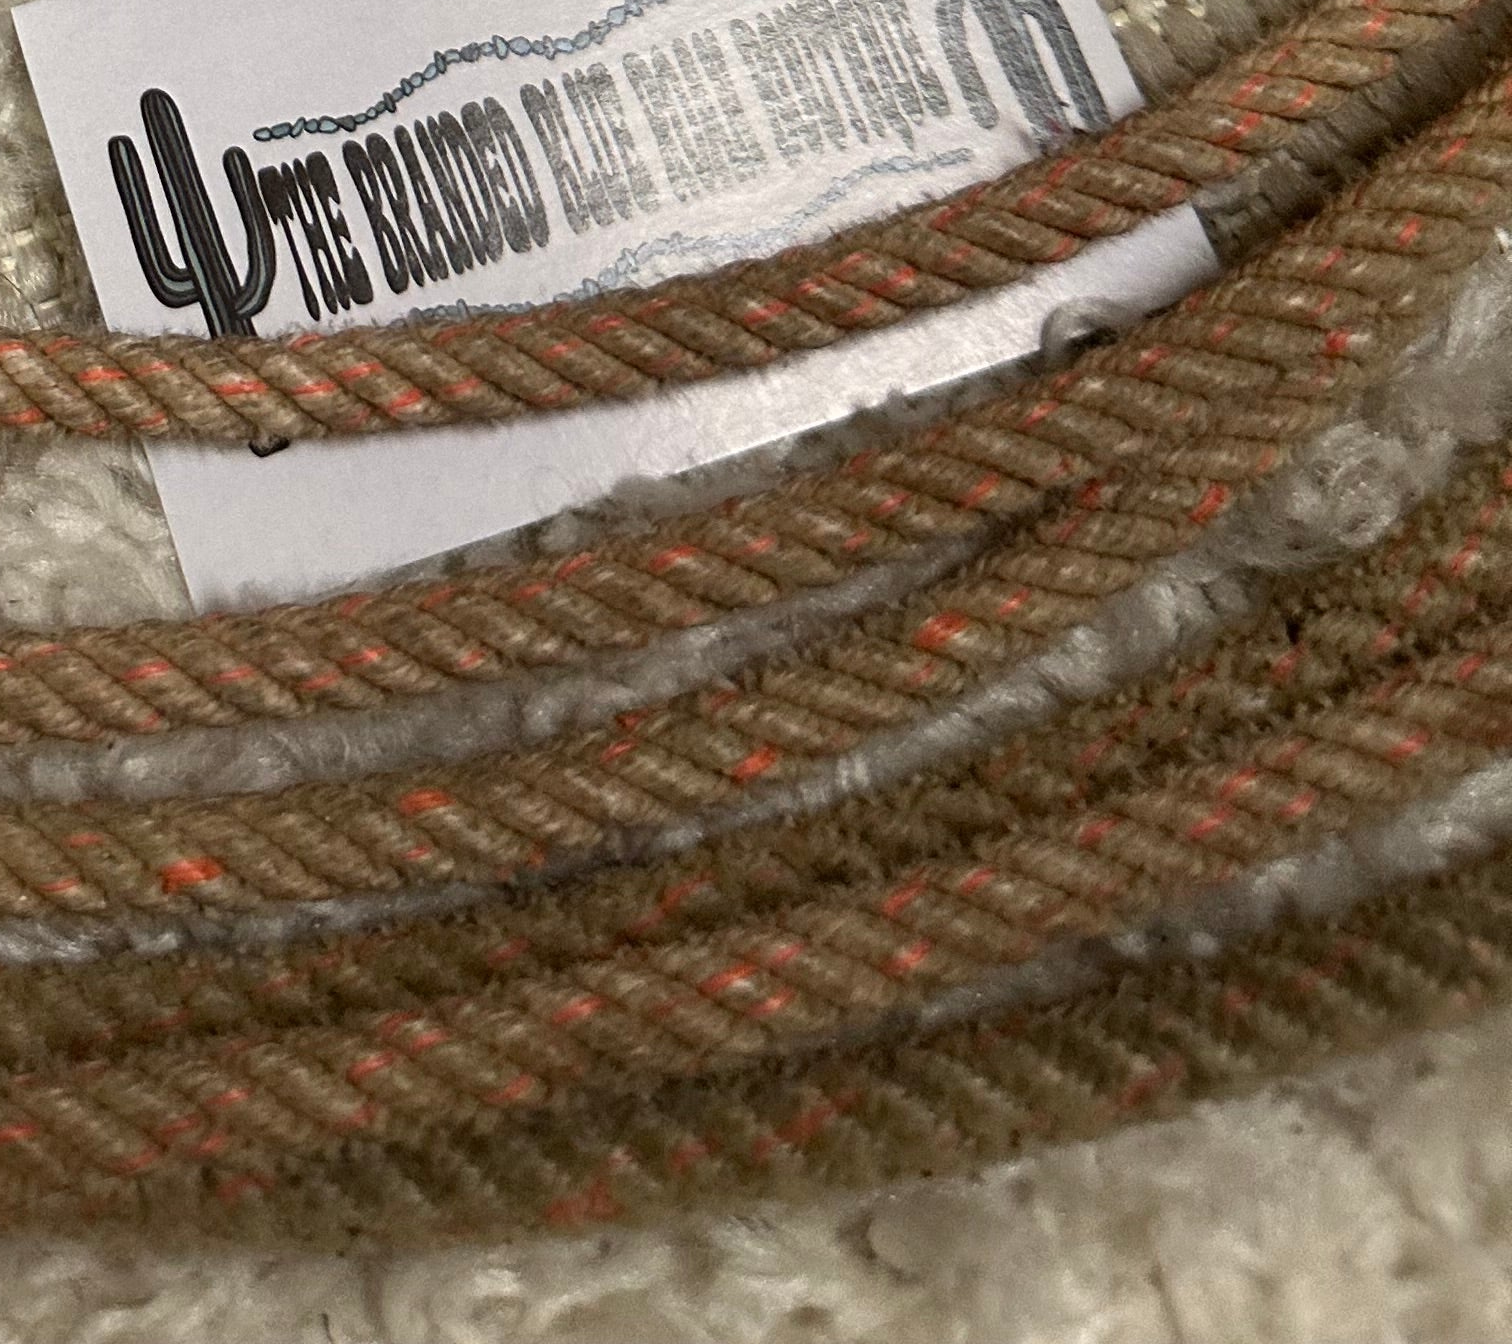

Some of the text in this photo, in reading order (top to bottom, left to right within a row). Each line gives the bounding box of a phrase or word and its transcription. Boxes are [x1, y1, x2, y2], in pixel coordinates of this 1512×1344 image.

[257, 151, 374, 322] THE
[342, 96, 550, 294] BRANDED
[519, 62, 660, 235] BLUE
